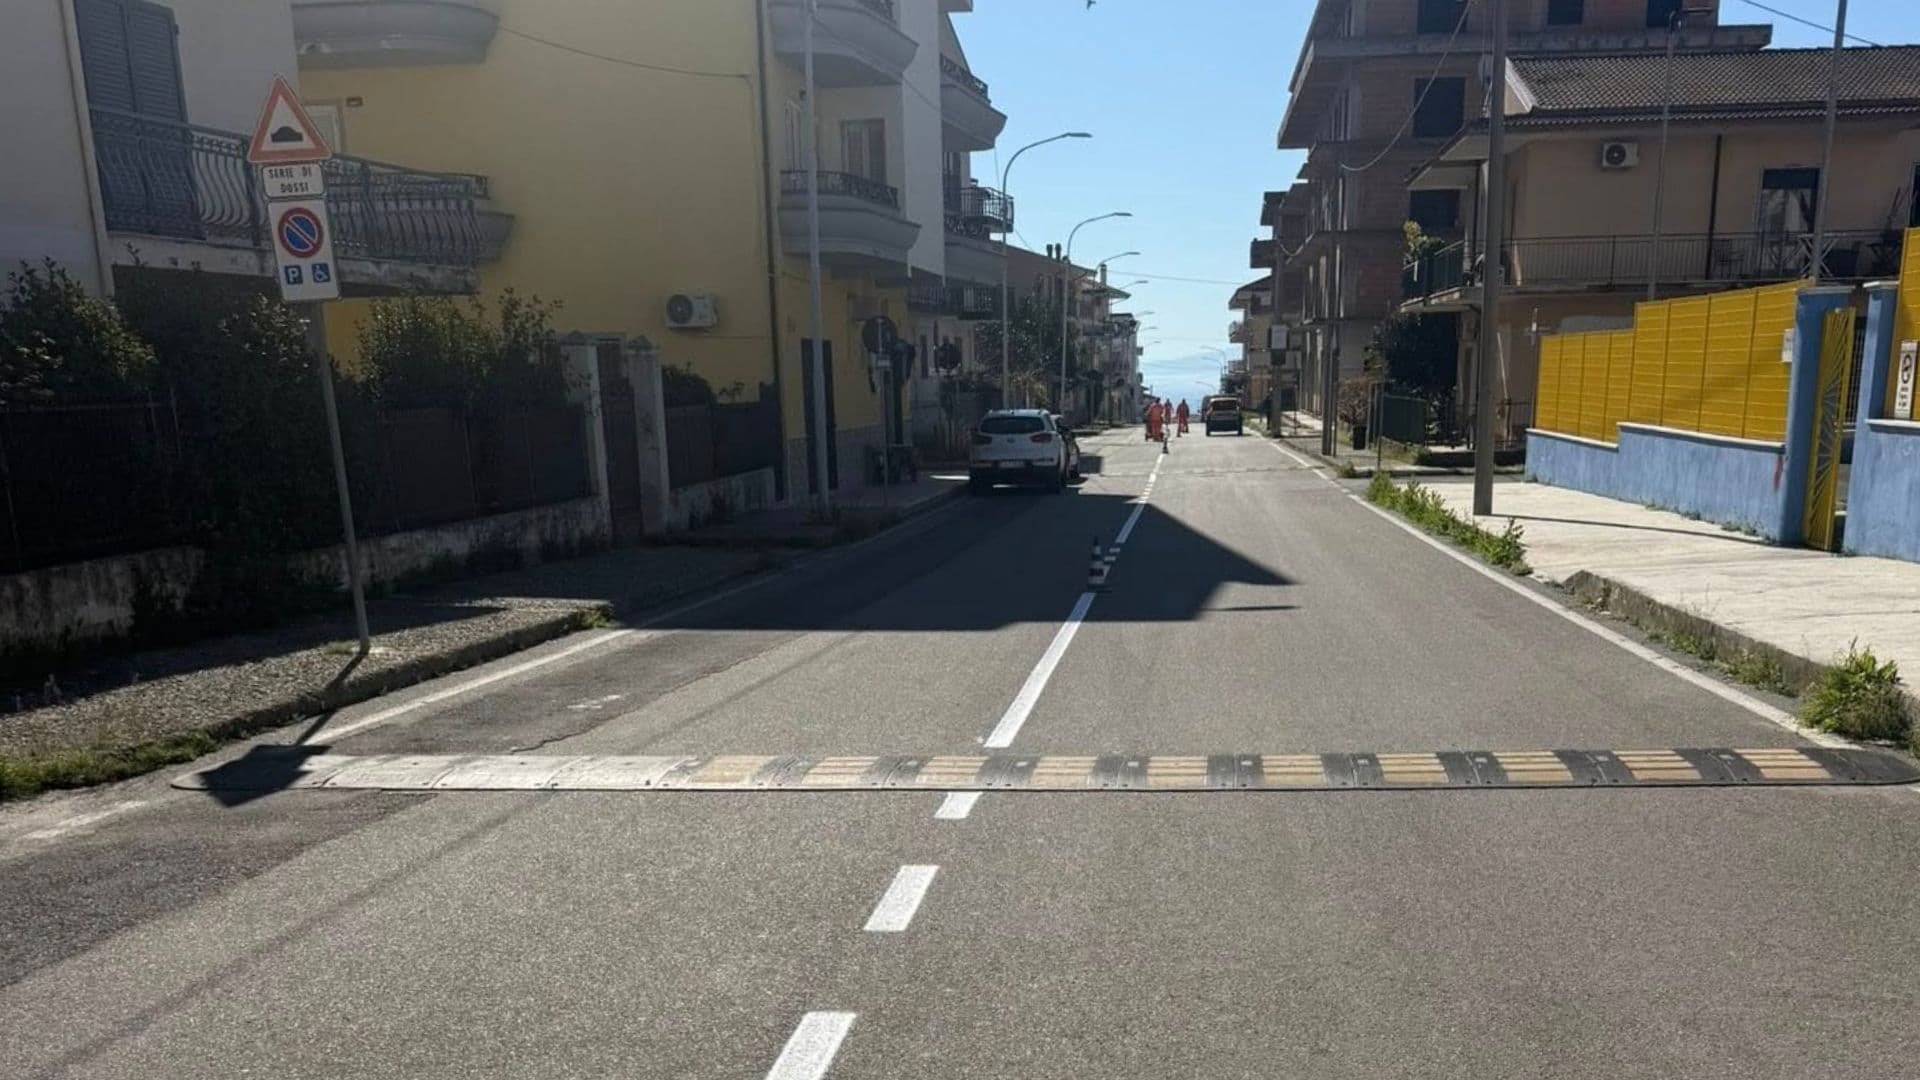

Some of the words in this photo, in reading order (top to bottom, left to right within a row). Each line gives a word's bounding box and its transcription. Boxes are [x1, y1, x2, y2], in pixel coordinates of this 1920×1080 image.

[268, 167, 293, 179] SERIE
[302, 166, 312, 177] DI
[280, 182, 309, 193] DOSSI
[288, 268, 299, 282] P
